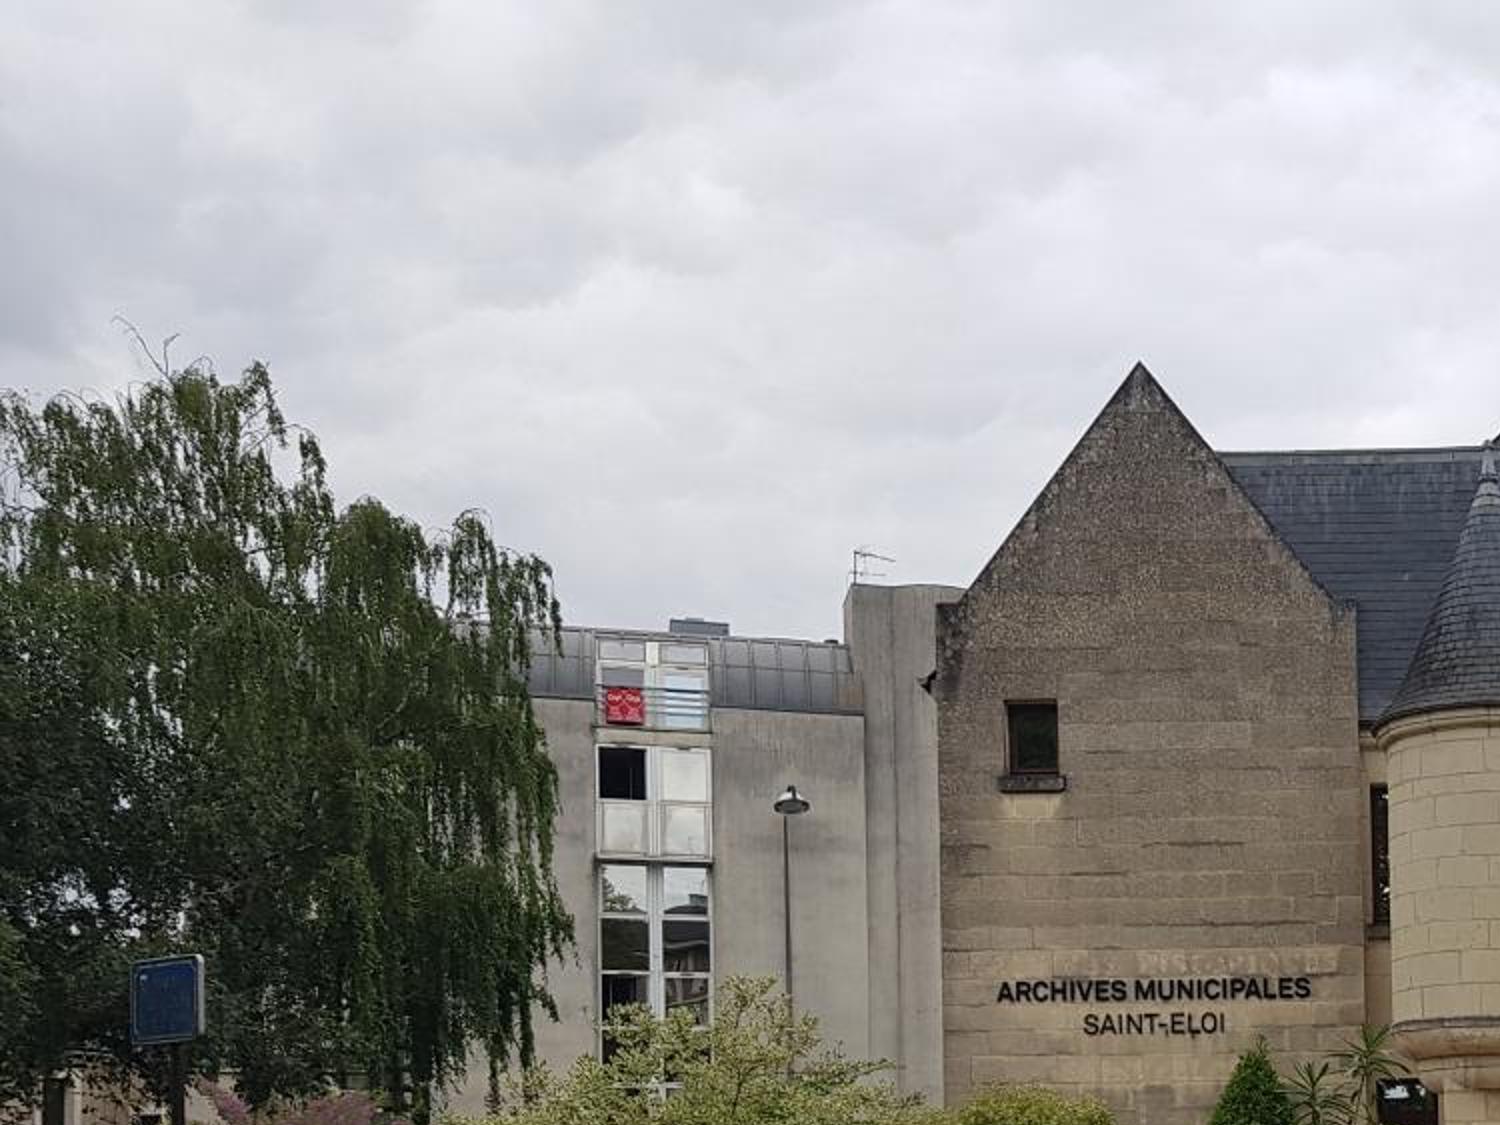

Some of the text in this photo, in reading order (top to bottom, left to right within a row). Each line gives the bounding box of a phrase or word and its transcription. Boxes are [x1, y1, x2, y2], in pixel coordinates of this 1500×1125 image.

[997, 977, 1311, 1003] ARCHIVES MUNICIPALES
[1083, 1012, 1225, 1036] SAINT-ELOI
